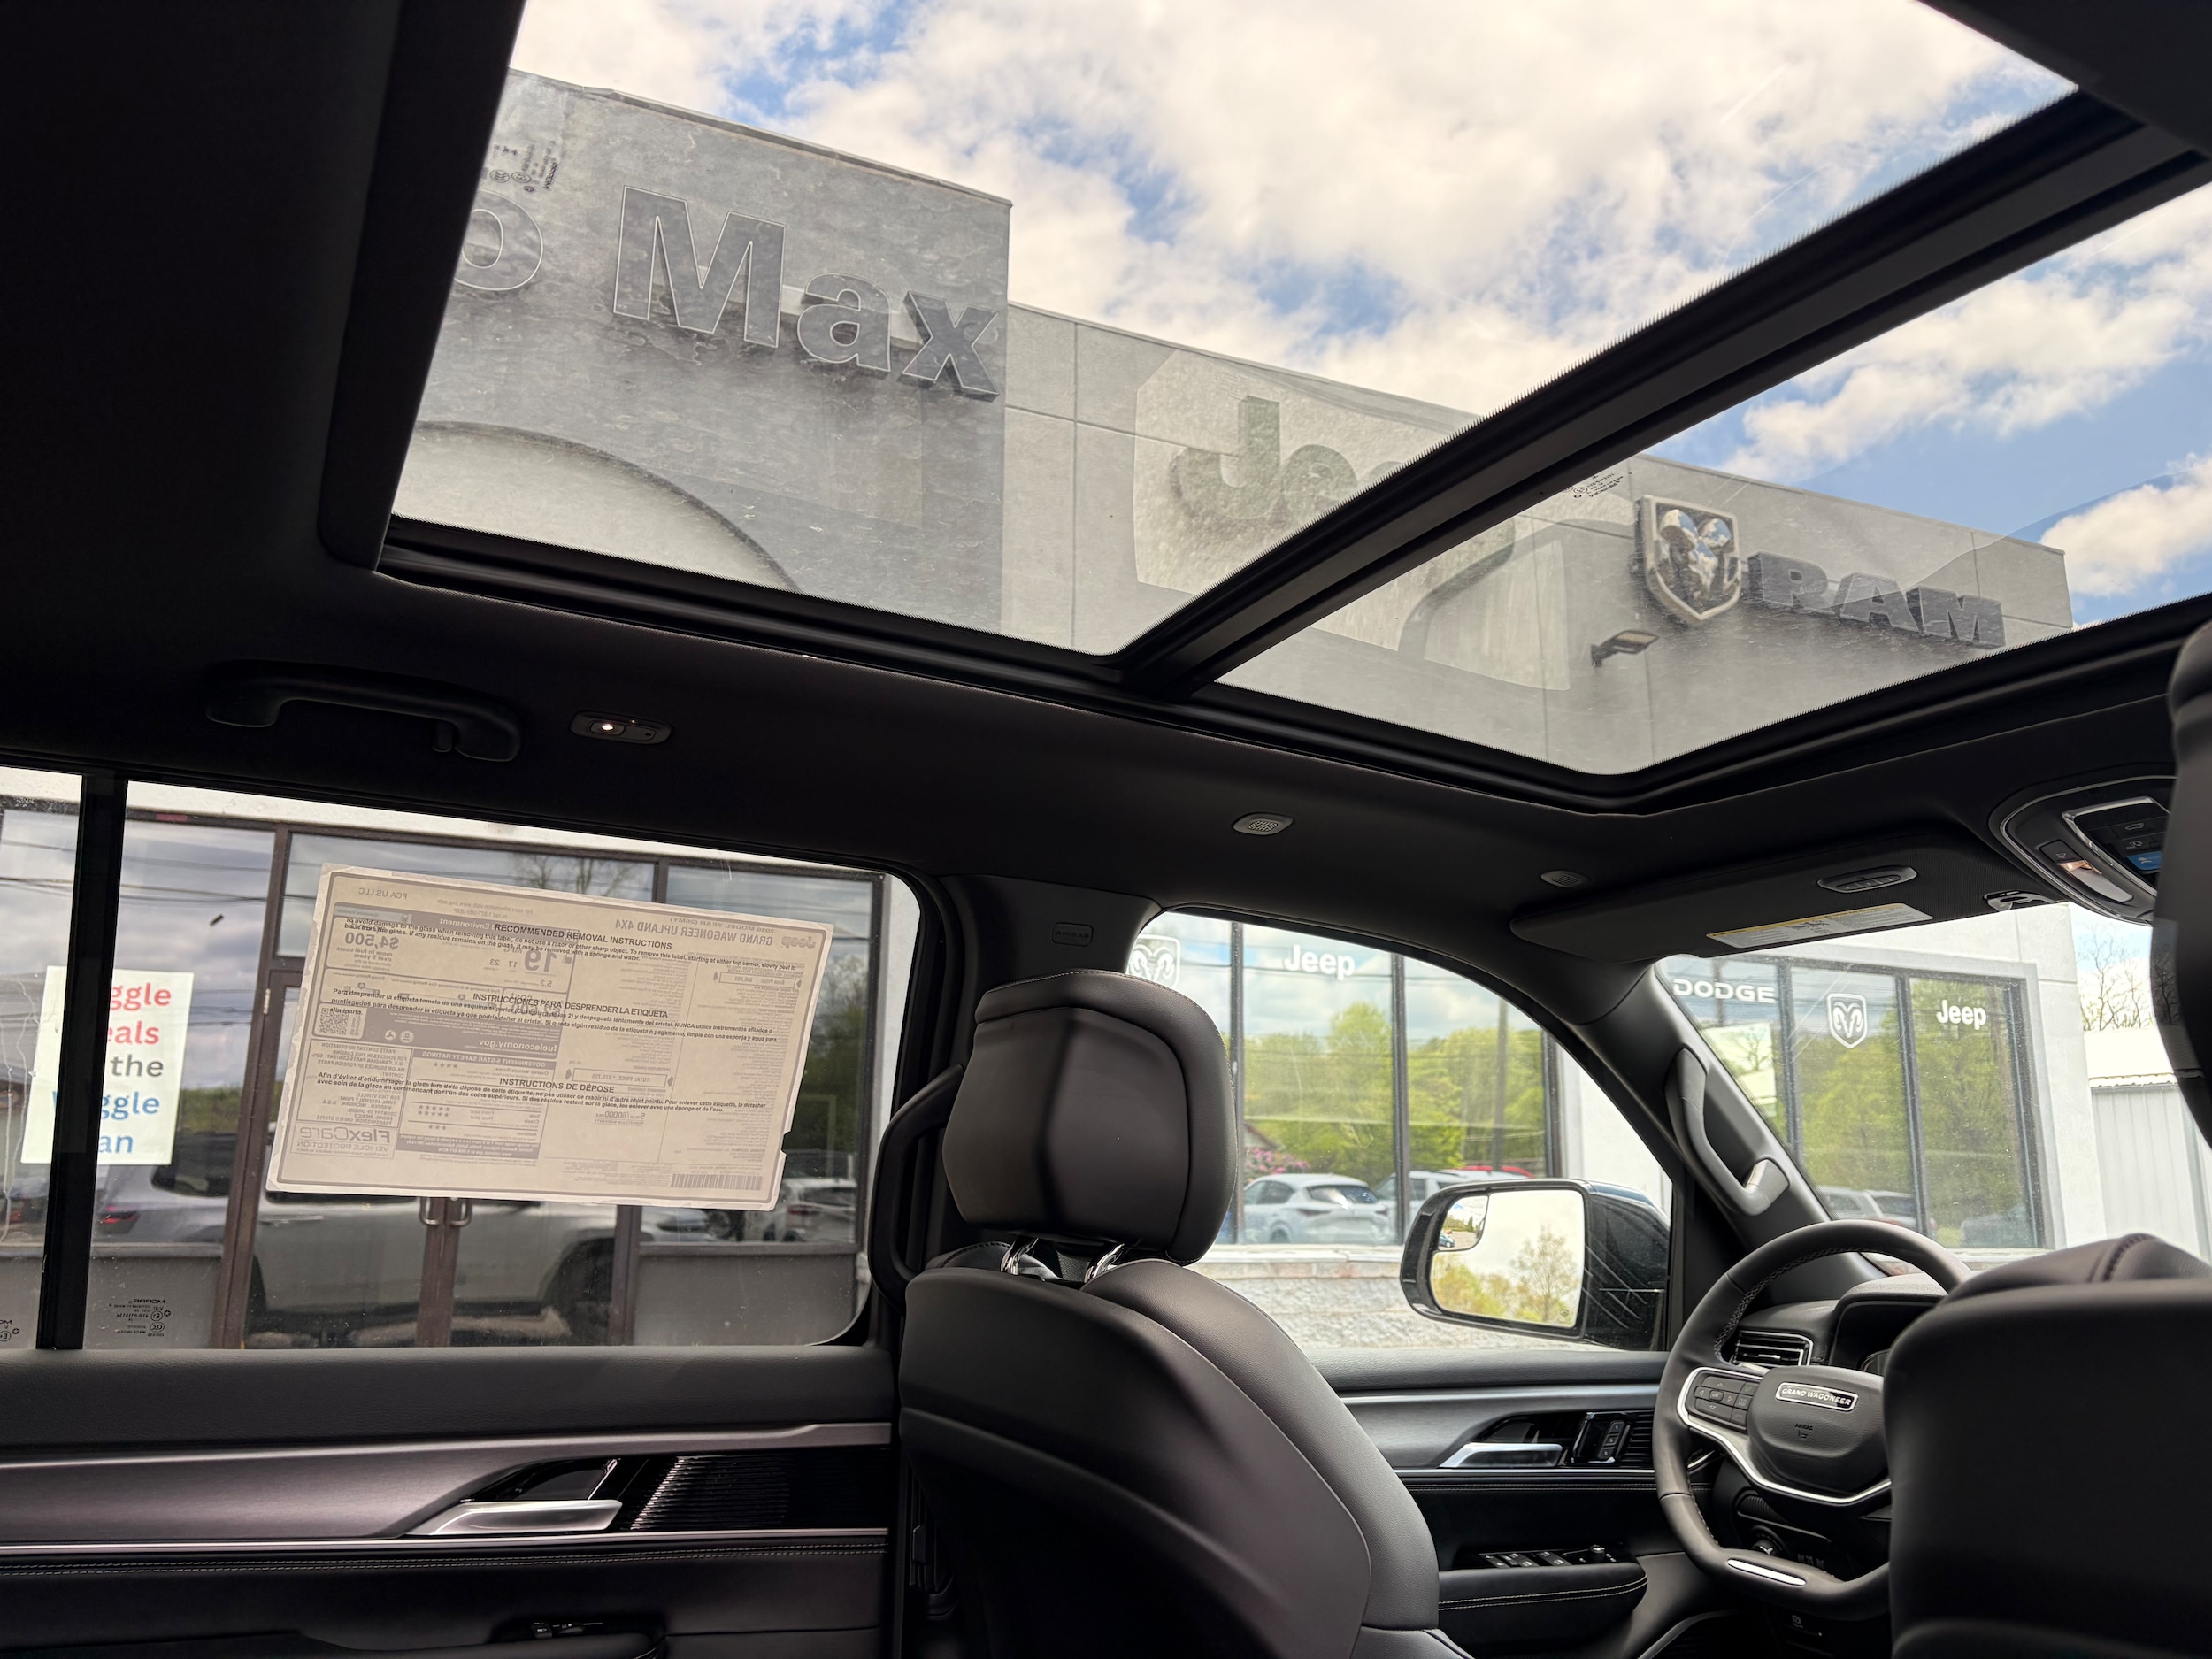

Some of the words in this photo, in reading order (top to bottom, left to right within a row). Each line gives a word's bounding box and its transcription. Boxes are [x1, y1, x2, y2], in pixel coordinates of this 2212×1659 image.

[613, 184, 1000, 402] Max
[1748, 550, 2007, 649] RAM
[373, 919, 399, 929] damage
[418, 925, 436, 933] glass
[454, 929, 484, 939] removing
[591, 944, 609, 953] sharp
[687, 955, 710, 964] starting
[451, 935, 477, 944] remains
[544, 946, 571, 955] removed
[494, 923, 565, 938] RECOMMENDED
[565, 931, 609, 942] REMOVAL
[609, 936, 672, 950] INSTRUCTIONS
[1284, 944, 1355, 981] Jeep
[111, 983, 172, 1010] ggle
[1672, 979, 1777, 1003] DODGE
[472, 993, 539, 1006] INSTRUCCIONES
[540, 999, 563, 1008] PARA
[564, 1002, 618, 1013] DESPRENDER
[630, 1008, 669, 1018] ETIQUETA
[1936, 999, 1986, 1030] Jeep
[108, 1020, 159, 1045] als
[111, 1055, 164, 1077] the
[499, 1078, 564, 1089] INSTRUCTIONS
[579, 1082, 615, 1093] DÉPOSE
[100, 1091, 160, 1120] ggle
[98, 1134, 134, 1154] an
[1781, 1388, 1806, 1397] GRAND
[1807, 1391, 1852, 1405] WAGONEER
